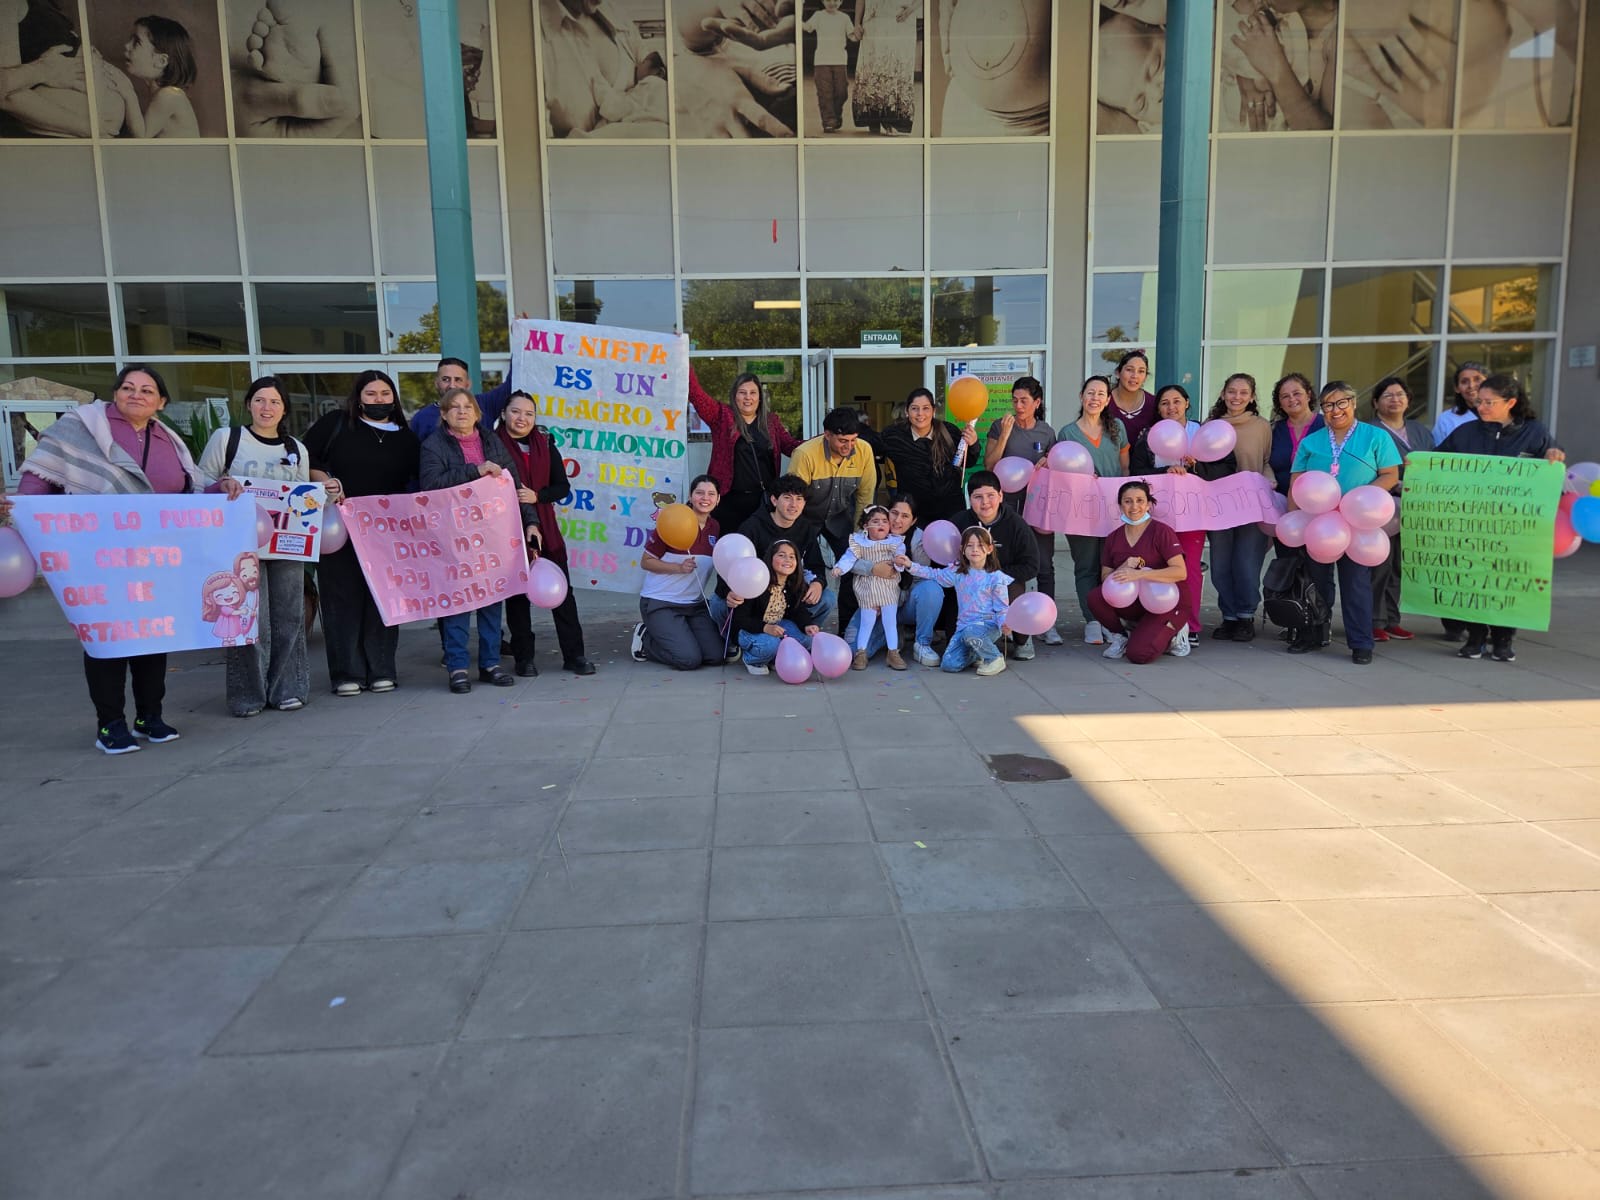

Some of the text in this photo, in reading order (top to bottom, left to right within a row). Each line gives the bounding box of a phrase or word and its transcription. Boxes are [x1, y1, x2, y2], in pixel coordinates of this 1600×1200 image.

[524, 330, 669, 365] MI NIETA
[863, 334, 898, 342] ENTRADA
[554, 365, 655, 397] ES UN
[662, 409, 681, 431] Y
[549, 426, 685, 459] STIMONIO
[598, 462, 656, 489] DEL
[617, 496, 637, 517] Y
[34, 508, 225, 534] TODO LO PUEDO
[357, 511, 441, 536] Porque
[454, 533, 484, 552] no
[1415, 534, 1508, 553] HOY NUESTROS
[40, 546, 182, 572] EN CRISTO
[446, 553, 500, 580] nada
[569, 549, 618, 574] IOS
[1402, 548, 1473, 570] CORAZONES
[63, 581, 155, 607] QUE ME
[70, 616, 176, 642] RTALECE
